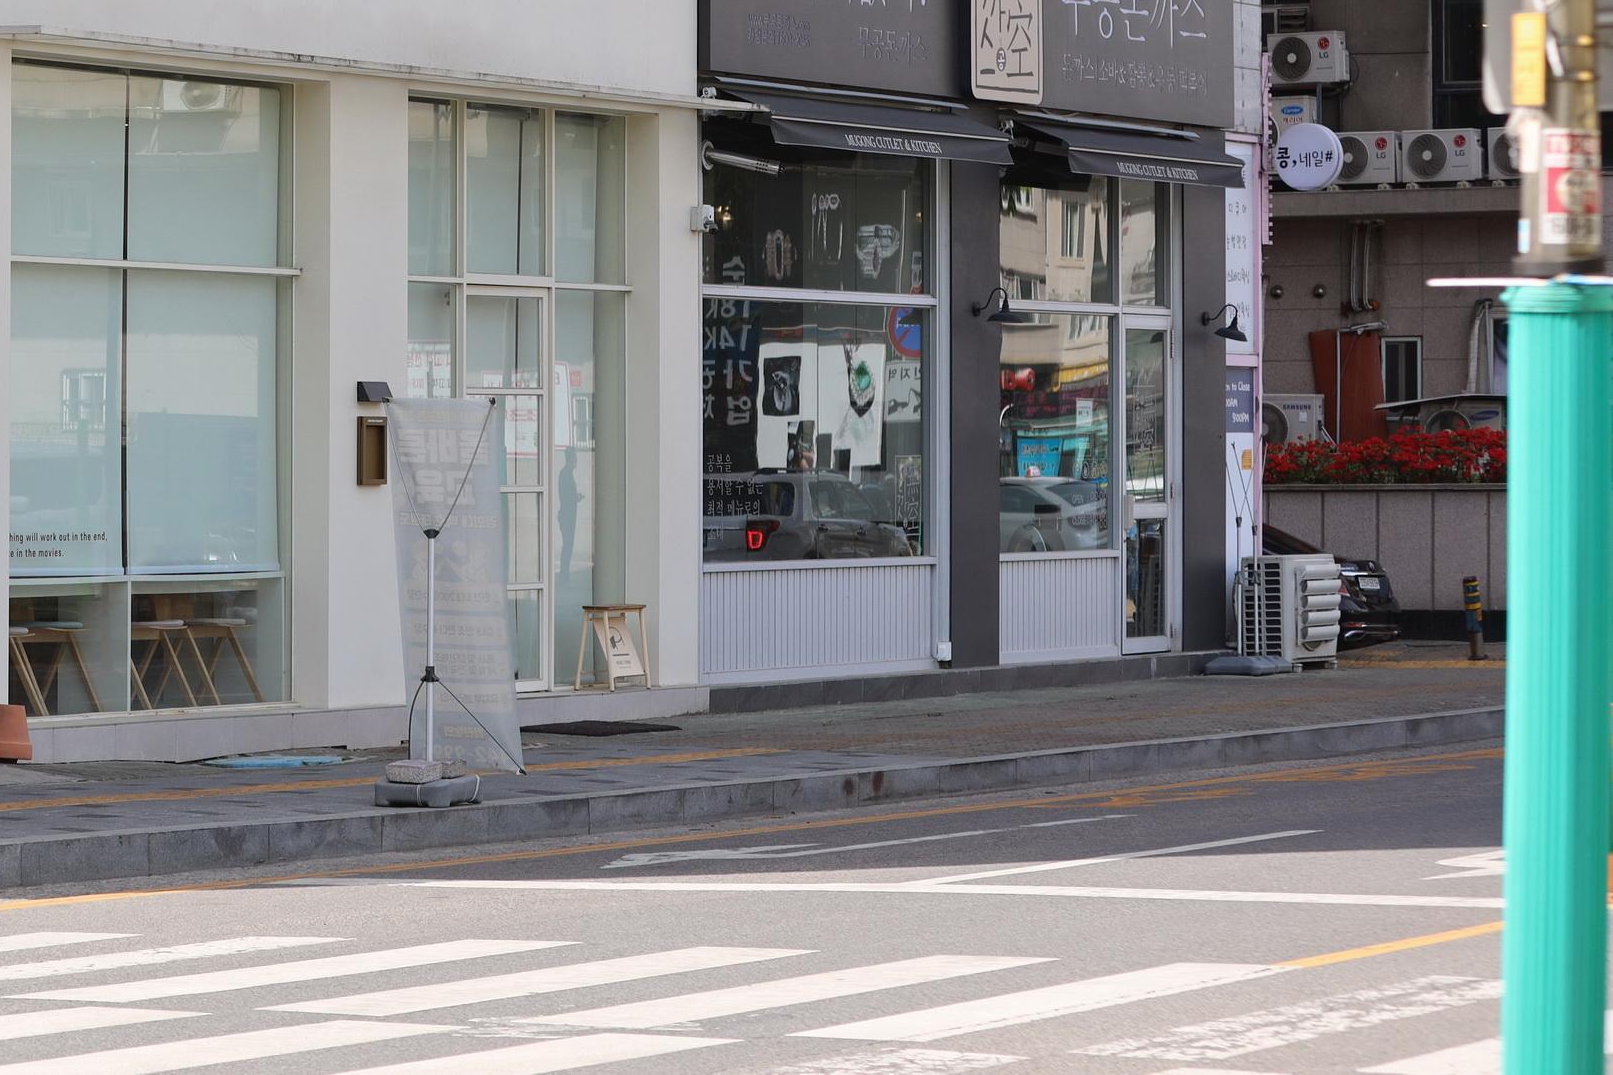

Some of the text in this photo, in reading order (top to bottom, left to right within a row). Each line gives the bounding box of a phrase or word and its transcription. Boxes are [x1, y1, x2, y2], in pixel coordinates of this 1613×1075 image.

[845, 133, 877, 148] MUGONG
[876, 136, 903, 150] CUTLET
[910, 139, 943, 155] KITCHEN
[1454, 149, 1466, 157] LG
[1116, 161, 1144, 175] MUGONG
[1142, 164, 1167, 178] CUTLET
[1171, 167, 1199, 180] KITCHEN
[9, 531, 107, 544] hing will work out in the end,
[16, 549, 23, 558] in
[25, 548, 36, 558] the
[38, 547, 64, 558] movies.
